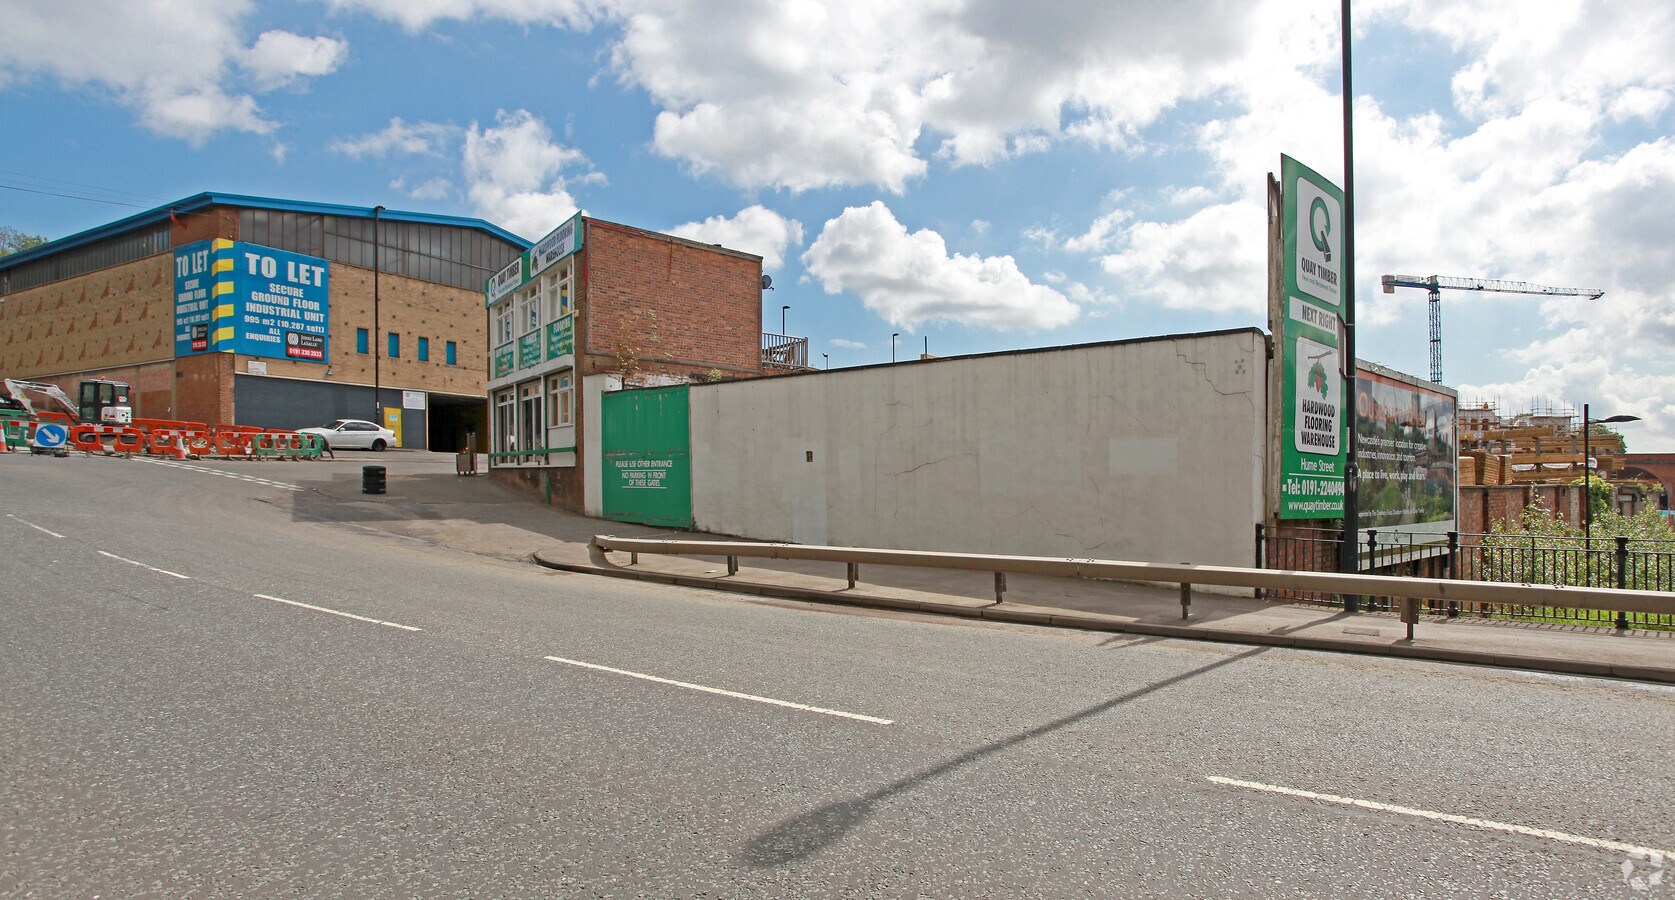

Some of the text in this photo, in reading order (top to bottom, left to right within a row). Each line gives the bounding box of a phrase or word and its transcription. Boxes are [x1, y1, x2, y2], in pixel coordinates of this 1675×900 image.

[176, 250, 208, 277] TO LET
[245, 252, 325, 287] TO LET
[1302, 257, 1337, 286] QUAY TIMBER
[269, 283, 304, 298] SECURE
[252, 291, 320, 311] GROUND FLOOR
[244, 315, 260, 324] 995
[262, 318, 275, 326] m2
[246, 302, 325, 323] INDUSTRIAL UNIT
[1302, 304, 1336, 331] NEXT RIGHT
[245, 332, 281, 343] ENQUIRIES
[1302, 399, 1335, 418] HARDWOOD
[1304, 415, 1332, 432] FLOORING
[1301, 431, 1335, 448] WAREHOUSE
[1301, 458, 1334, 472] Hume Street
[1357, 468, 1361, 478] A
[1362, 469, 1374, 481] place
[1287, 478, 1300, 495] Tel:
[1288, 500, 1344, 513] www.quaytimber.co.uk
